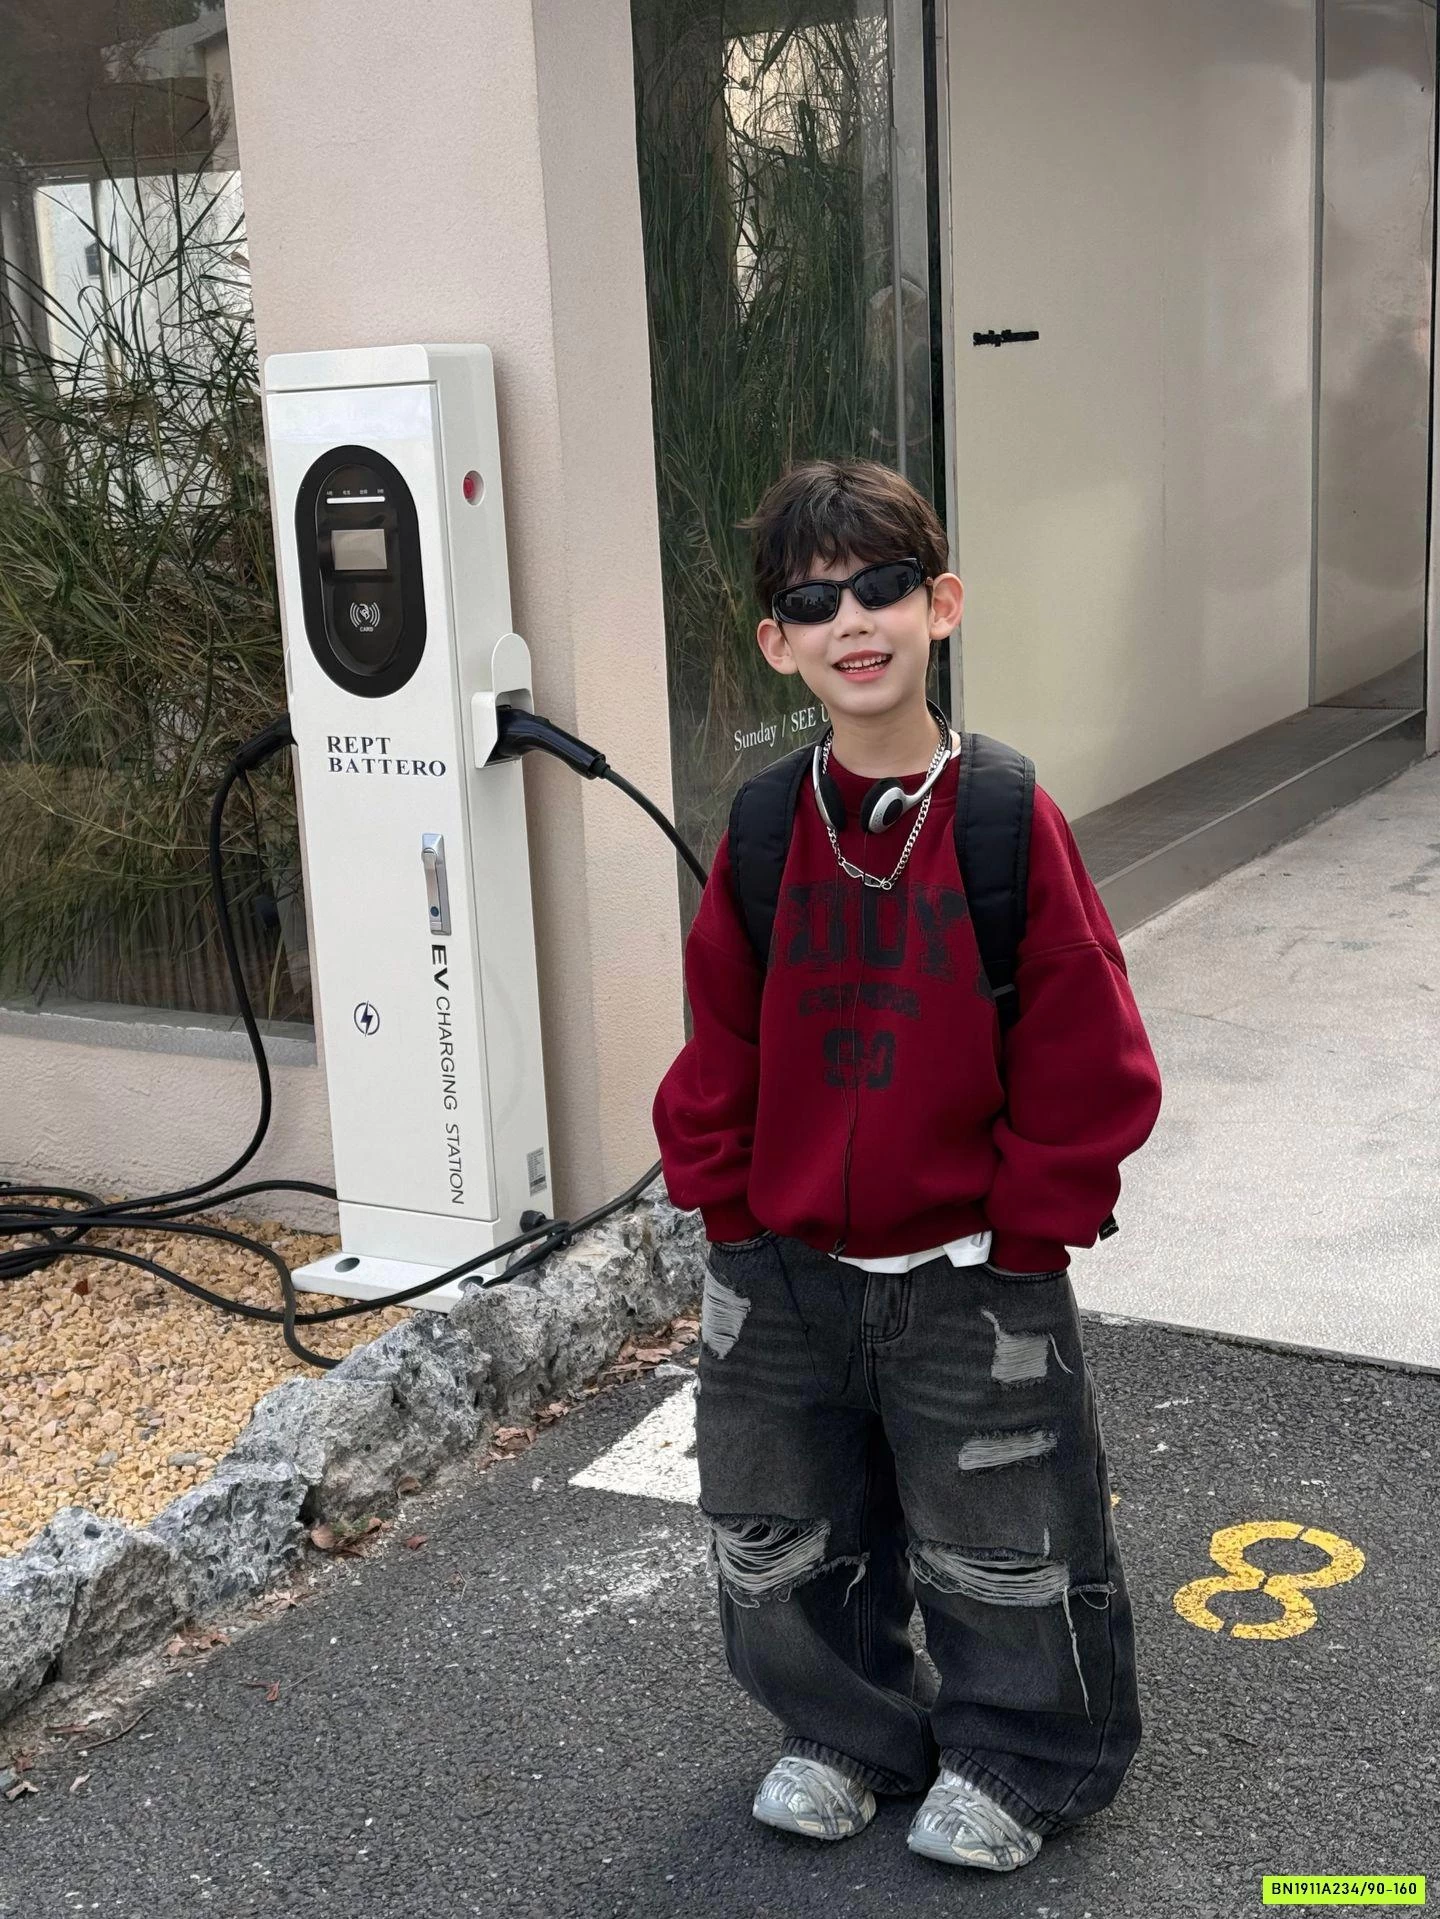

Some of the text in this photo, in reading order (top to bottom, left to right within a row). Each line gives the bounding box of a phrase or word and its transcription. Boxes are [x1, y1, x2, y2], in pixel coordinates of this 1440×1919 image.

[327, 736, 391, 755] REPT
[734, 722, 777, 751] Sunday
[782, 714, 786, 738] /
[791, 706, 817, 733] SEE
[329, 757, 446, 777] BATTERO
[431, 944, 465, 1205] EV CHARGING STATION
[1173, 1521, 1366, 1641] 8
